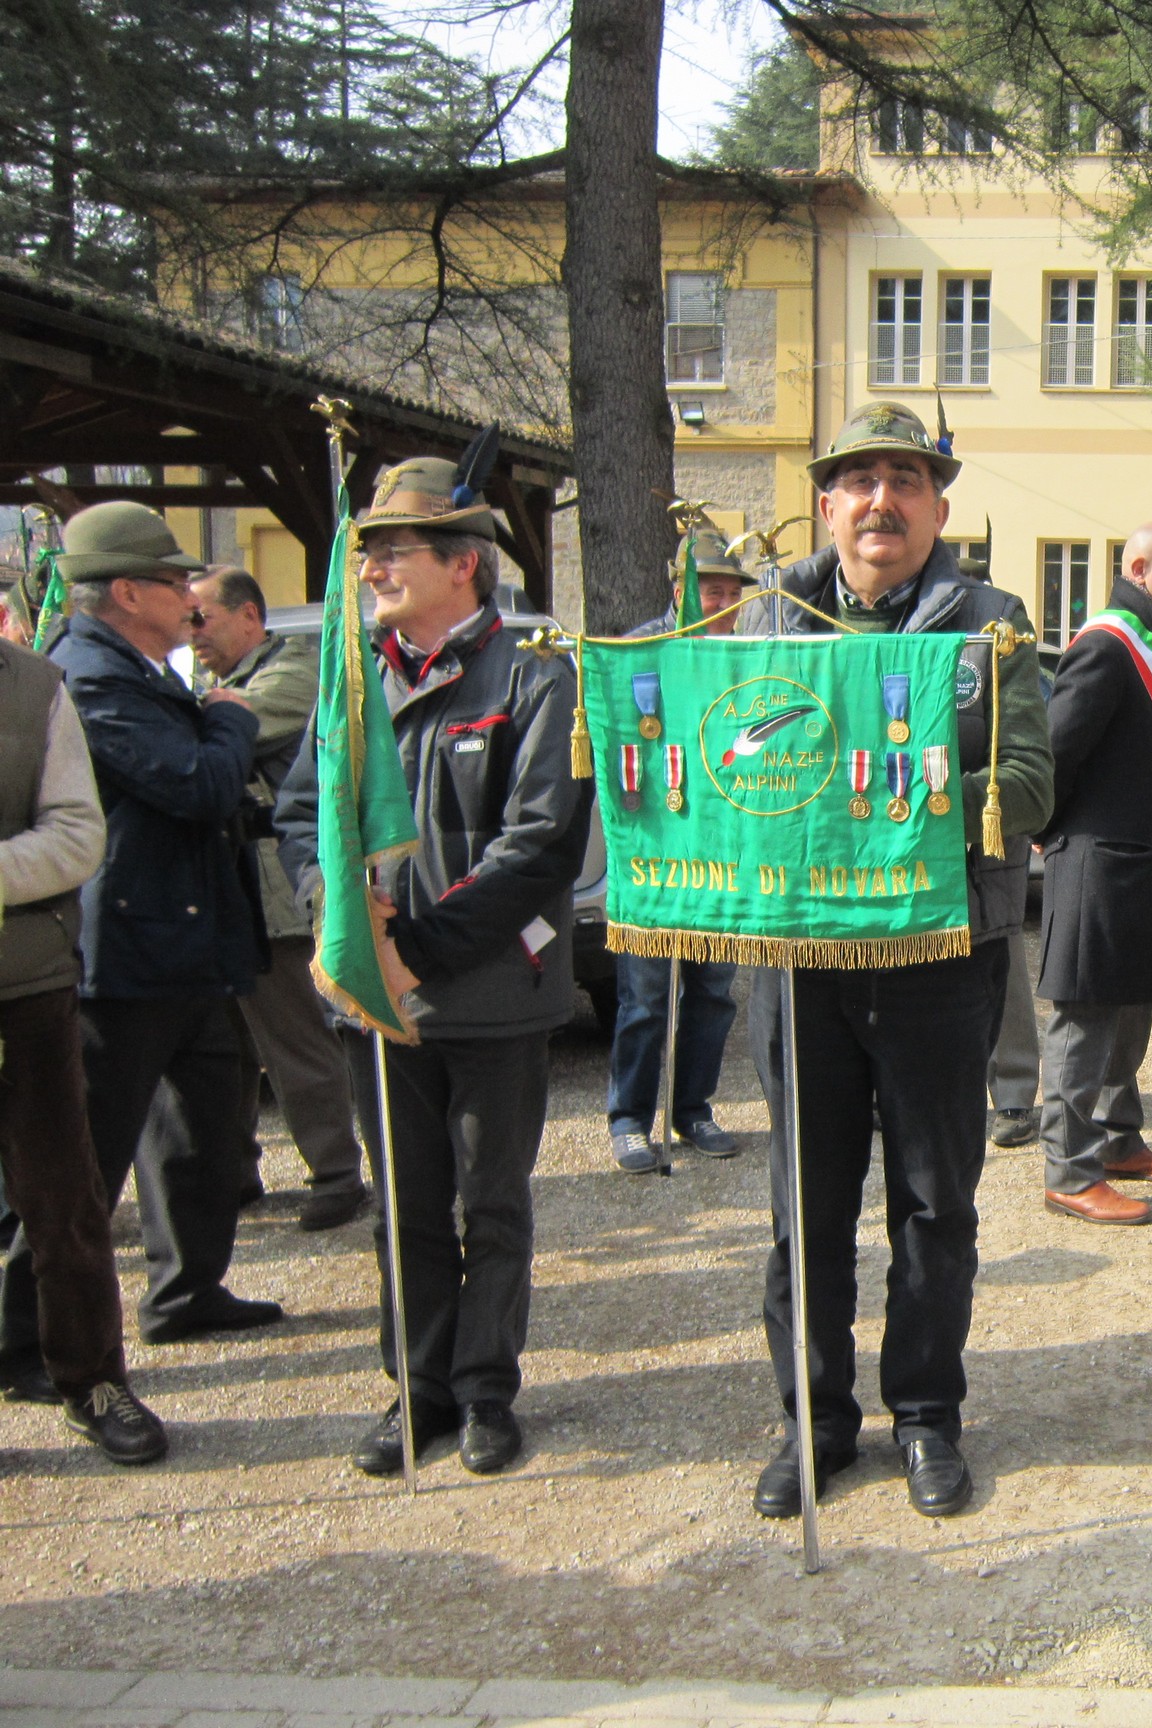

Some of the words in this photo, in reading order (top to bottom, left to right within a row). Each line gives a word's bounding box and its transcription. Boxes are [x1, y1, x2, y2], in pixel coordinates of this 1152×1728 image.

[733, 775, 798, 792] ALPINI
[629, 856, 739, 892] SEZIONE
[758, 863, 786, 896] DI
[809, 860, 932, 898] NOVARA
